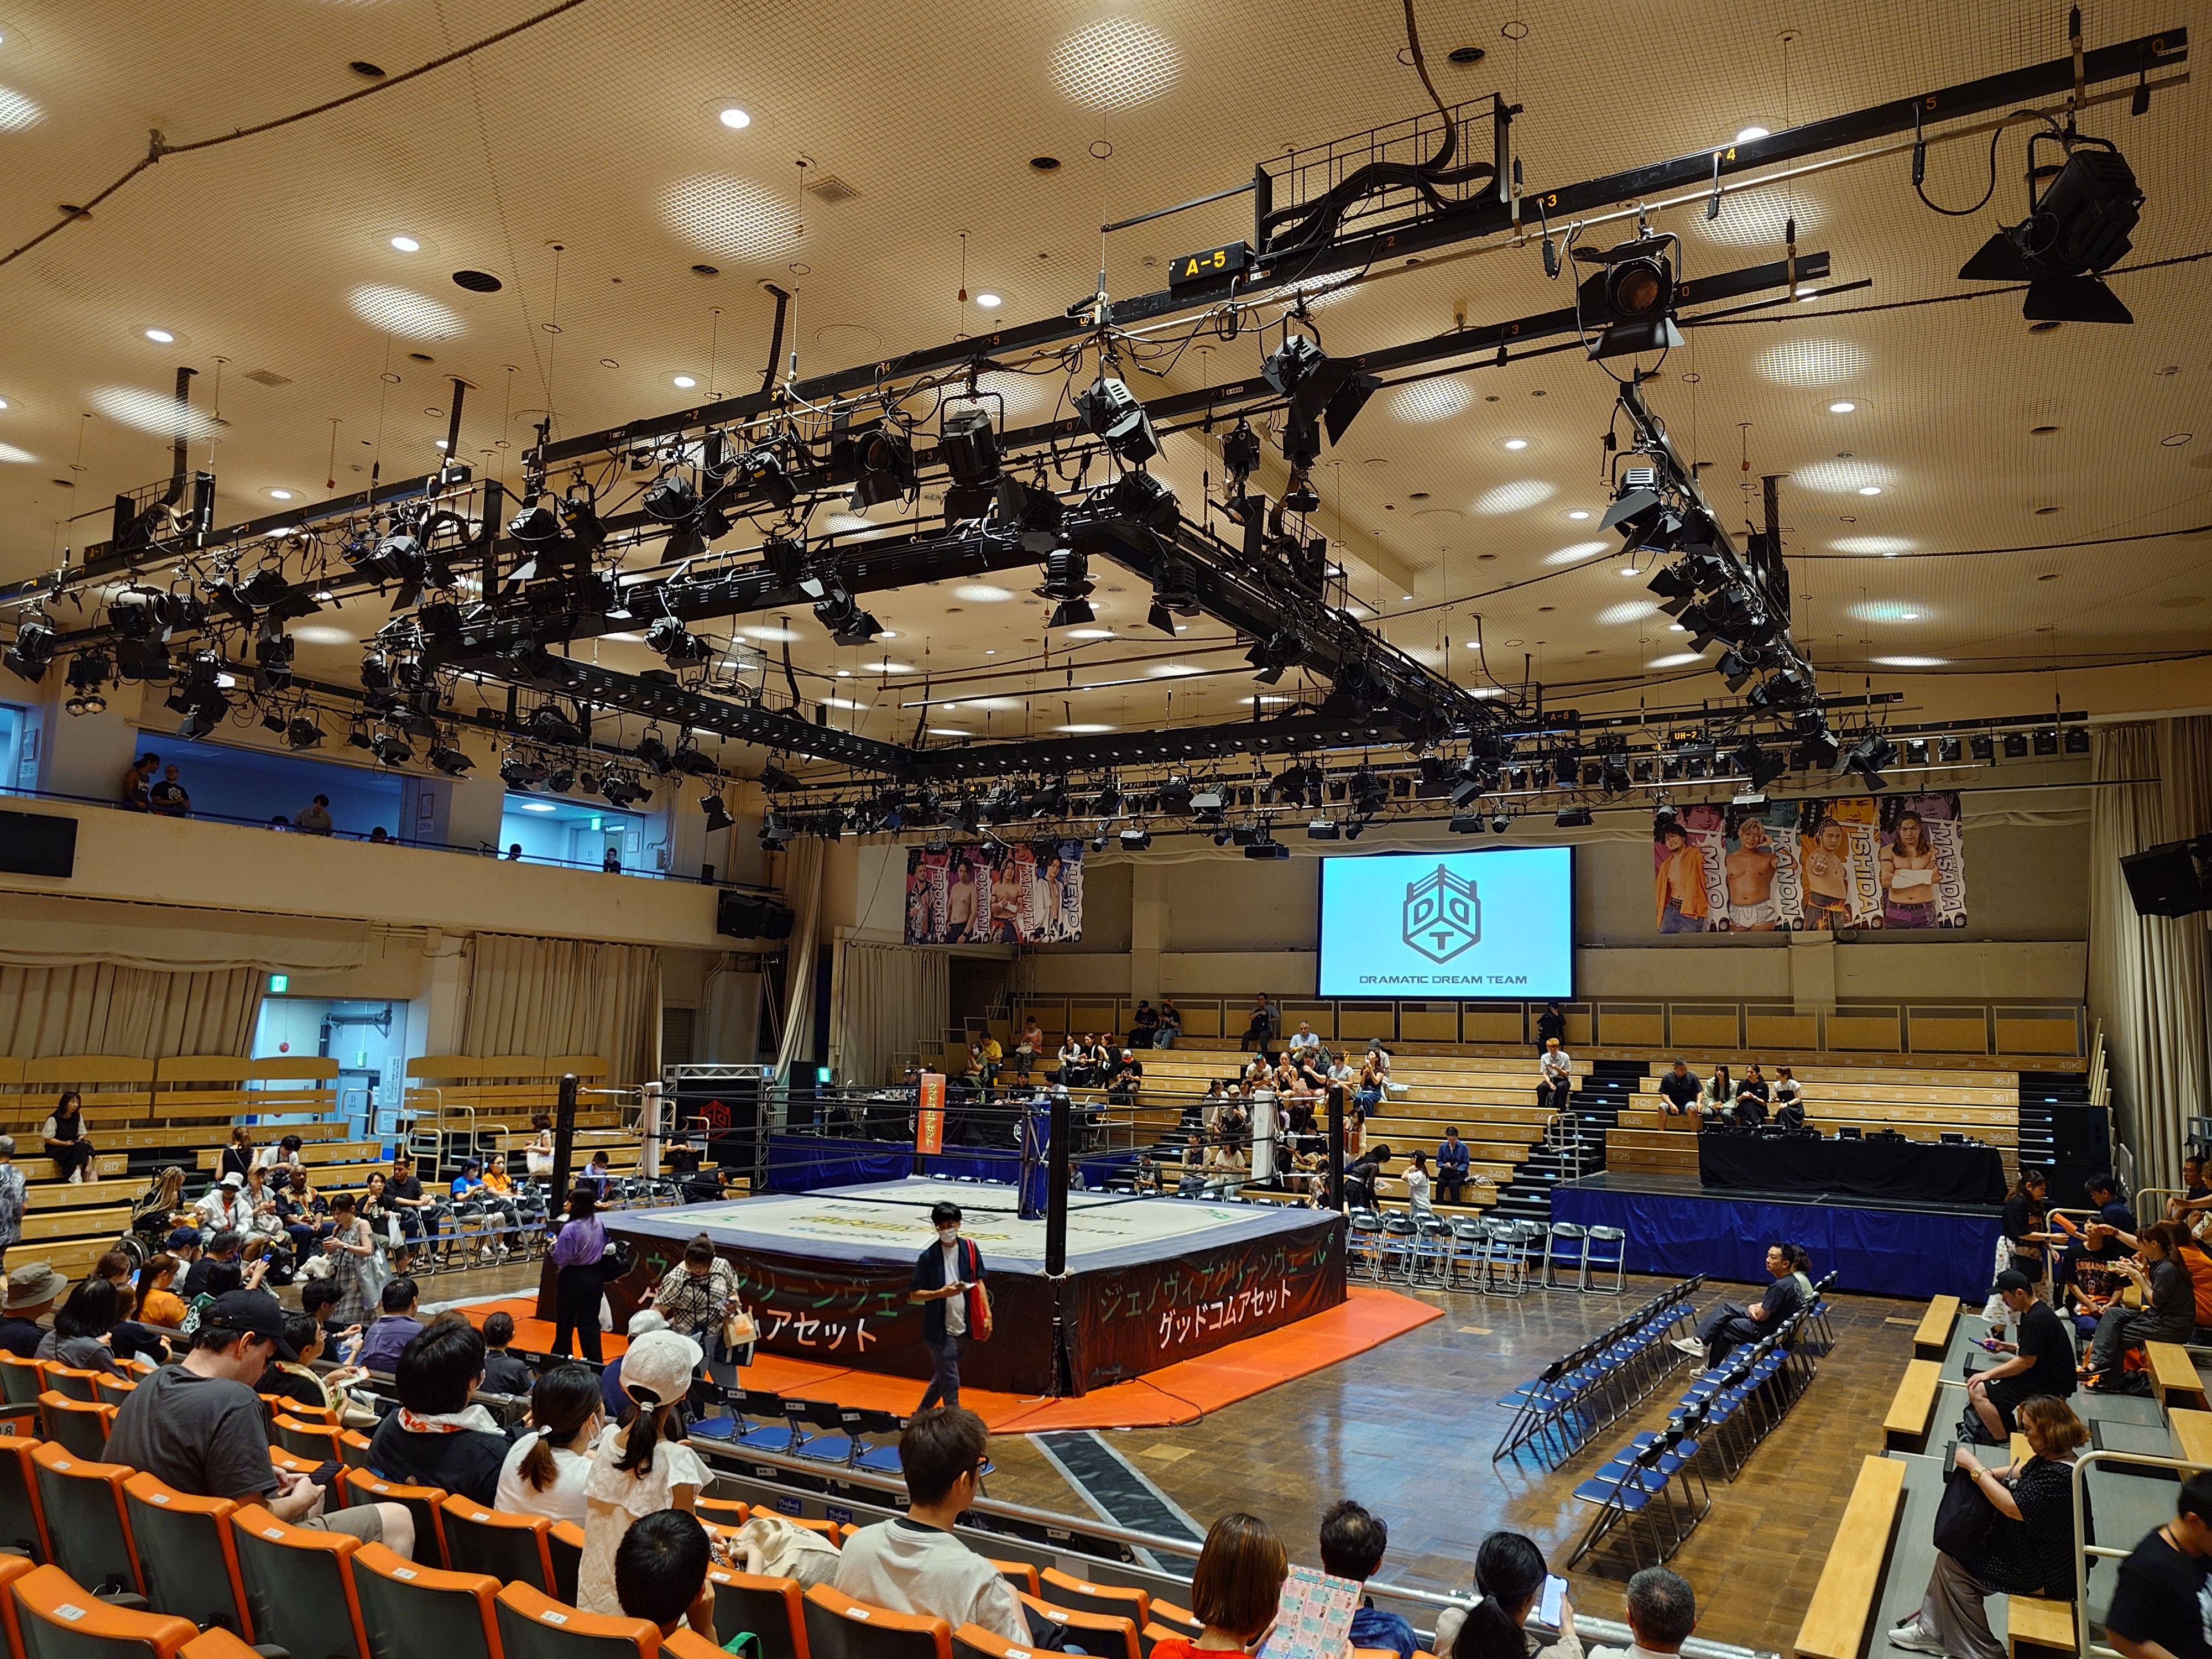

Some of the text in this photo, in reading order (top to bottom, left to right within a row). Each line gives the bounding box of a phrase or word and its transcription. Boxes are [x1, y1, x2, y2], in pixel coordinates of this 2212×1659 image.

[1926, 97, 1937, 110] 5
[1726, 148, 1736, 161] 4
[1547, 194, 1557, 207] 3
[1387, 236, 1396, 247] 2
[1185, 250, 1226, 276] A-5
[1682, 285, 1690, 297] 0
[1511, 324, 1519, 335] 3
[993, 335, 1000, 345] 5
[885, 362, 891, 372] 4
[771, 391, 778, 401] 3
[693, 410, 698, 420] 2
[1066, 421, 1072, 431] 0
[927, 451, 933, 460] 3
[826, 473, 832, 481] 2
[89, 546, 104, 559] A-1
[857, 545, 862, 553] 3
[490, 711, 505, 721] A-3
[1550, 711, 1569, 721] A-8
[1674, 731, 1697, 740] UH-2
[1849, 832, 1880, 915] ISHIDA
[1931, 828, 1962, 912] MASADA
[1952, 854, 1960, 883] TAKESHI
[1699, 846, 1724, 909] MAO
[1771, 836, 1800, 916] KANON
[933, 872, 945, 933] BROOKES
[976, 871, 989, 932] OKATANI
[1021, 868, 1035, 932] KATSUMATA
[1066, 869, 1079, 928] UENO
[1359, 975, 1527, 984] DRAMATIC DREAM TEAM
[1992, 1077, 2011, 1085] 36J
[351, 1095, 356, 1103] D
[925, 1082, 938, 1146] グッドコムアセット
[1990, 1113, 2011, 1121] 36H
[1624, 1117, 1642, 1125] G25
[1520, 1131, 1536, 1139] 24F
[1989, 1133, 2010, 1142] 36G
[126, 1136, 134, 1146] E
[357, 1147, 367, 1156] 14
[1504, 1150, 1521, 1159] 24E
[103, 1162, 119, 1172] 8D
[1488, 1169, 1506, 1178] 24D
[100, 1191, 106, 1199] 7
[1470, 1192, 1489, 1201] 24C
[1159, 1279, 1292, 1349] グッドコムアセット
